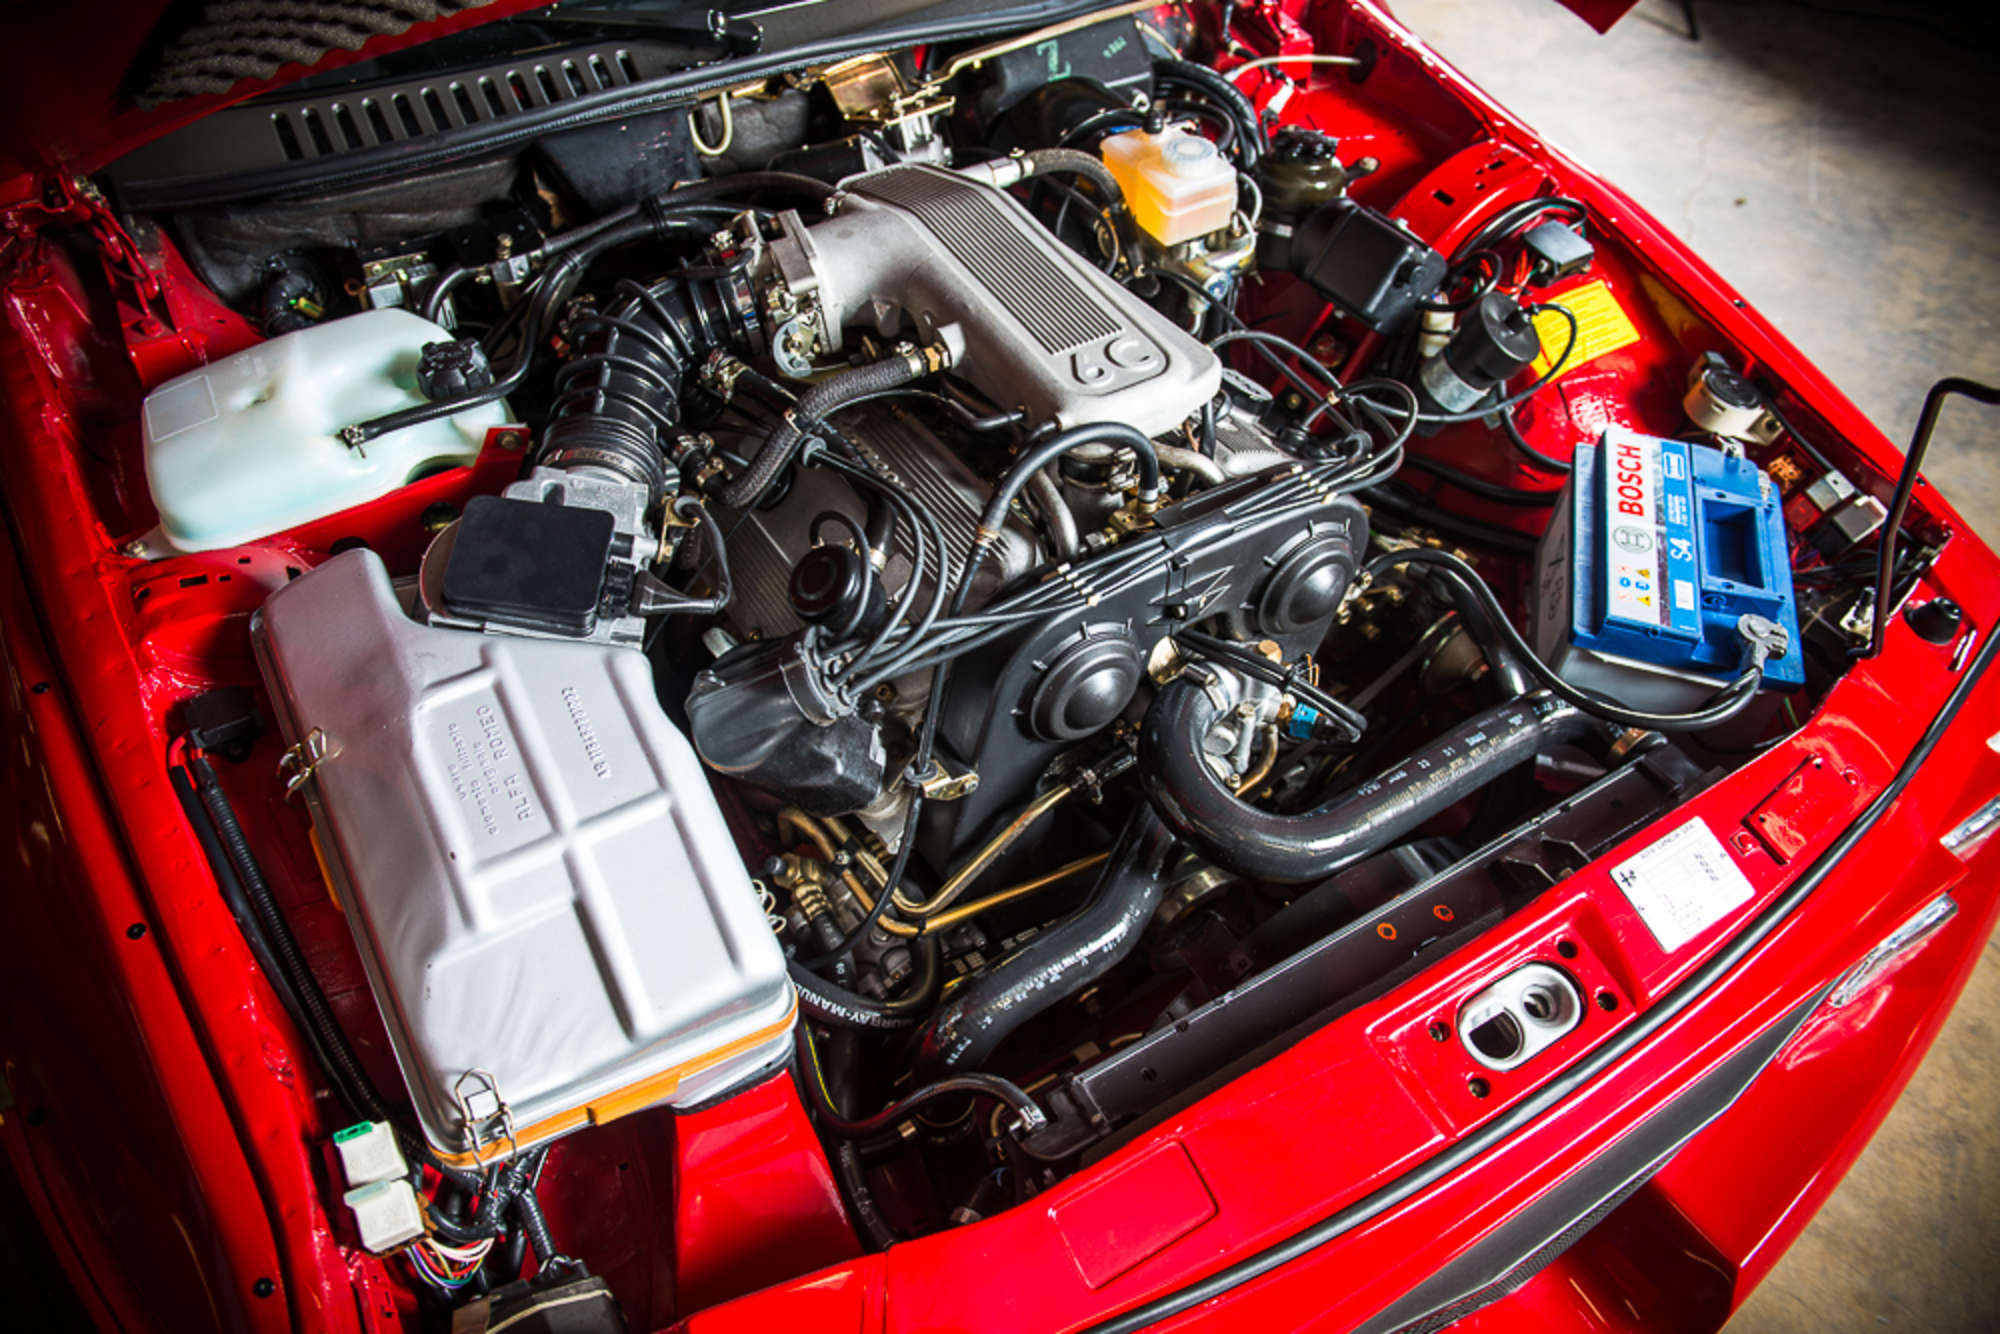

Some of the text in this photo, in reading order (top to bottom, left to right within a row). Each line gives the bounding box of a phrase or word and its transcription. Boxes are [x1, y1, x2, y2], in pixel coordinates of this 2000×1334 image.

[1616, 443, 1645, 517] BOSCH
[1669, 537, 1692, 563] S4
[475, 704, 535, 821] ALFA ROMEO
